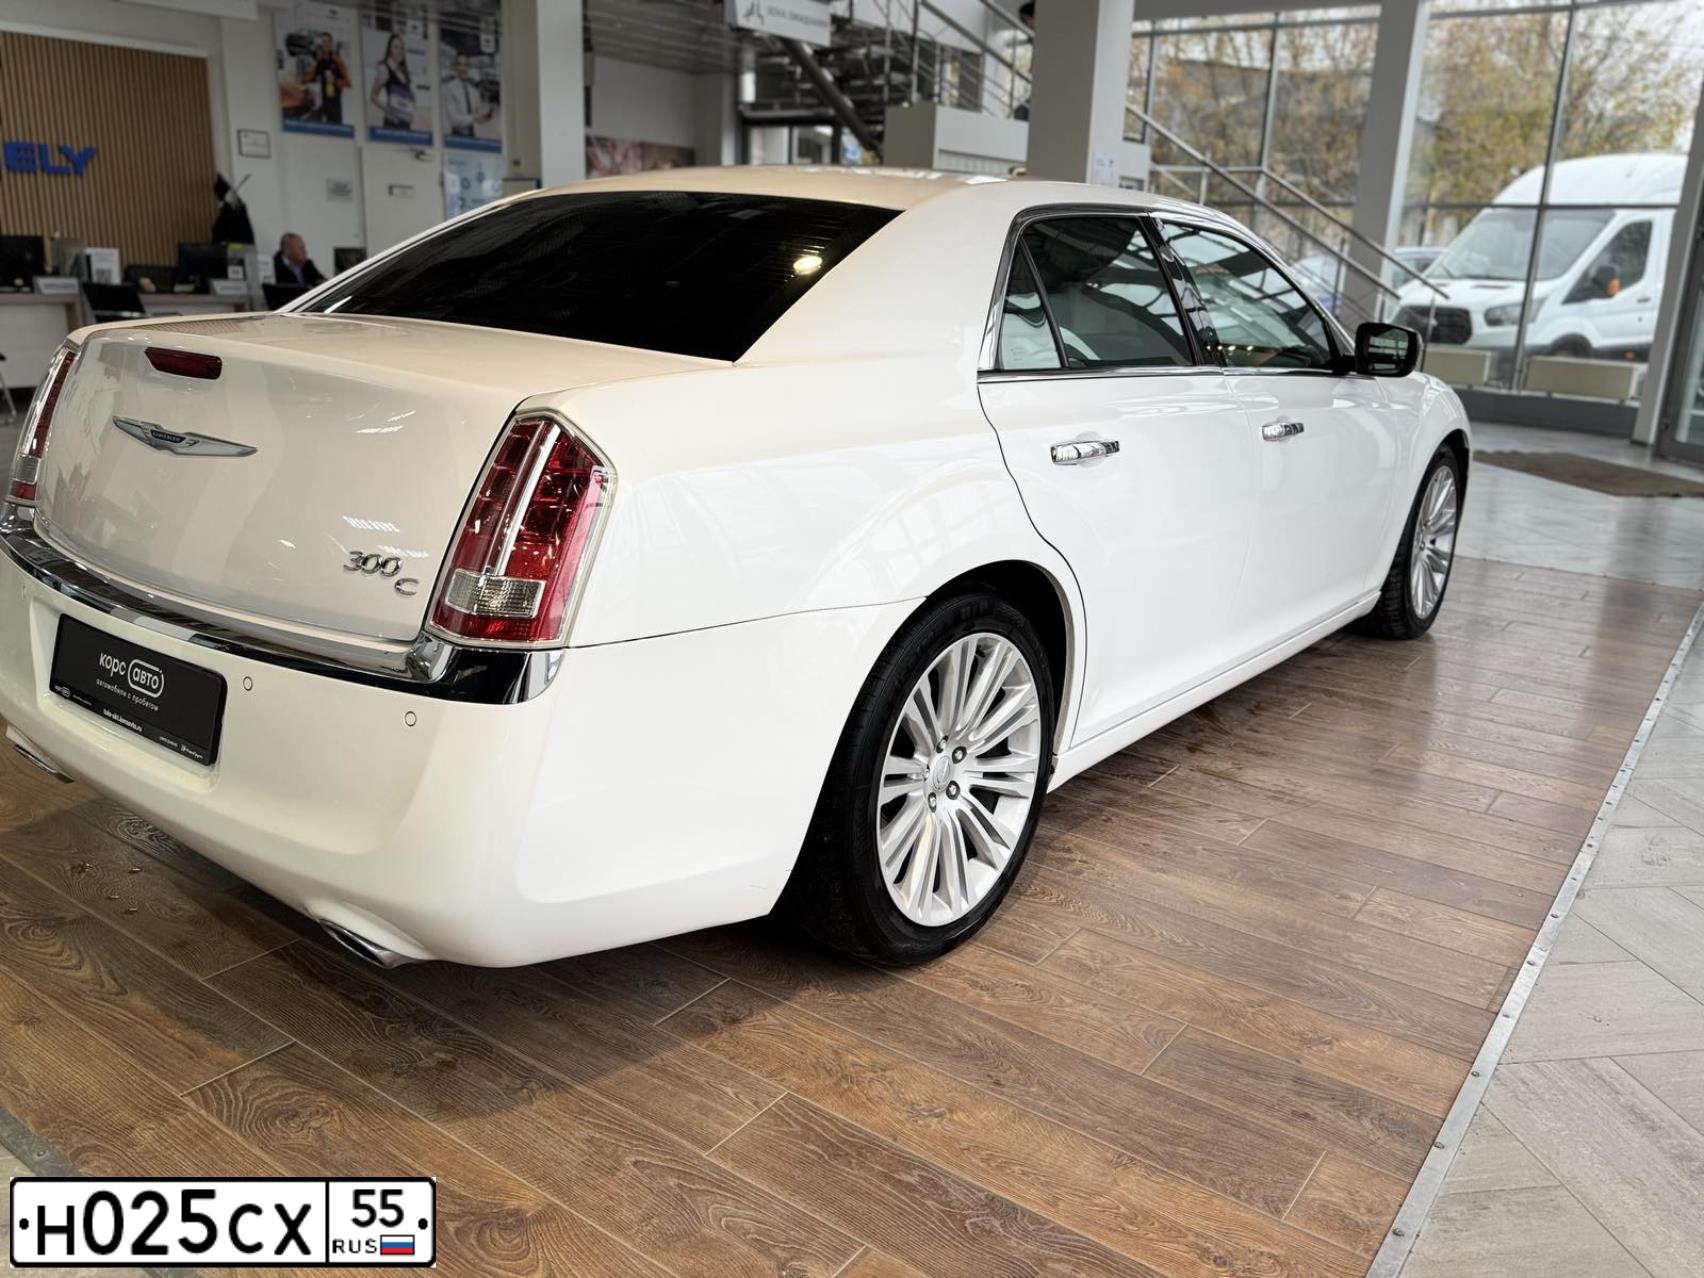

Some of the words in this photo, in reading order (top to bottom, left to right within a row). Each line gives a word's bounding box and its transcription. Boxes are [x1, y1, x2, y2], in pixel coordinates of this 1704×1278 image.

[4, 140, 97, 175] ELY
[343, 551, 402, 577] 300
[394, 578, 420, 596] C
[99, 652, 127, 677] корс
[132, 667, 160, 690] авто
